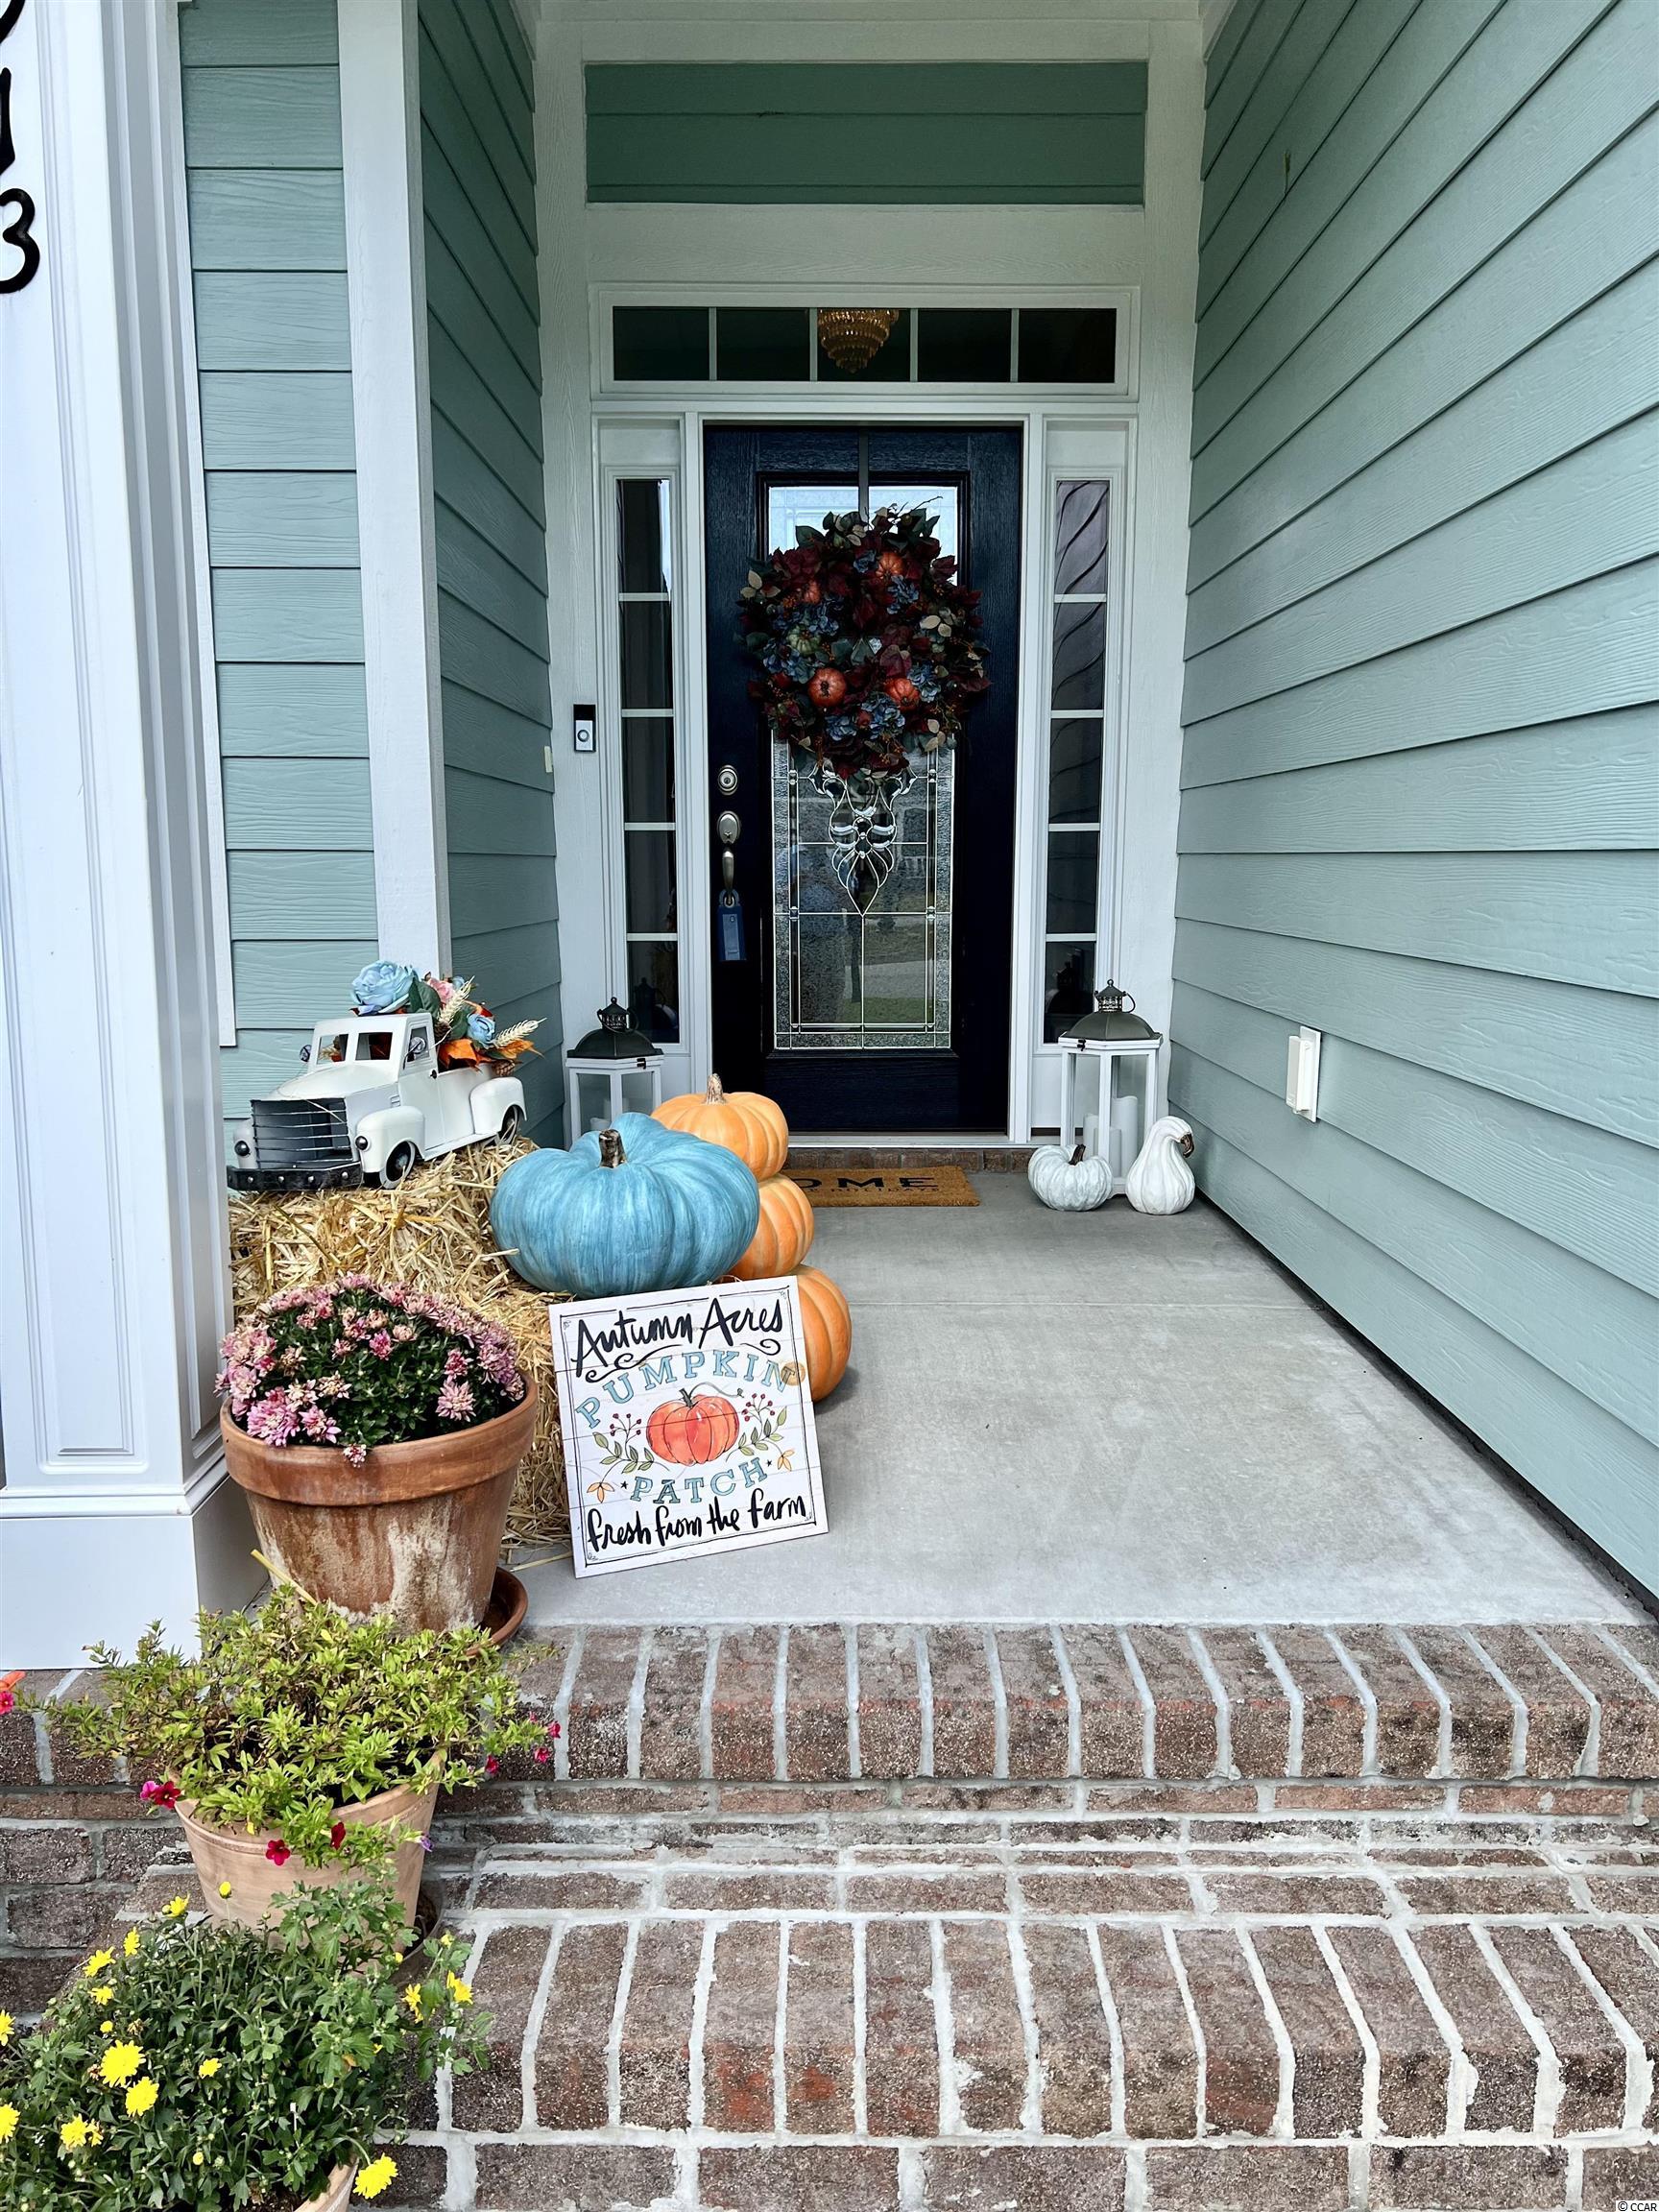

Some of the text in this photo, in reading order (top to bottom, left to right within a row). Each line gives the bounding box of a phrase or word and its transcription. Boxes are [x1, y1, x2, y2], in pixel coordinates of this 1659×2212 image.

[791, 1177, 939, 1189] OME
[570, 1297, 783, 1377] Autumn Acres
[575, 1349, 796, 1430] PUMPKIN
[629, 1456, 769, 1504] PATCH
[655, 1504, 703, 1547] from
[706, 1496, 741, 1531] the
[747, 1487, 807, 1528] farm
